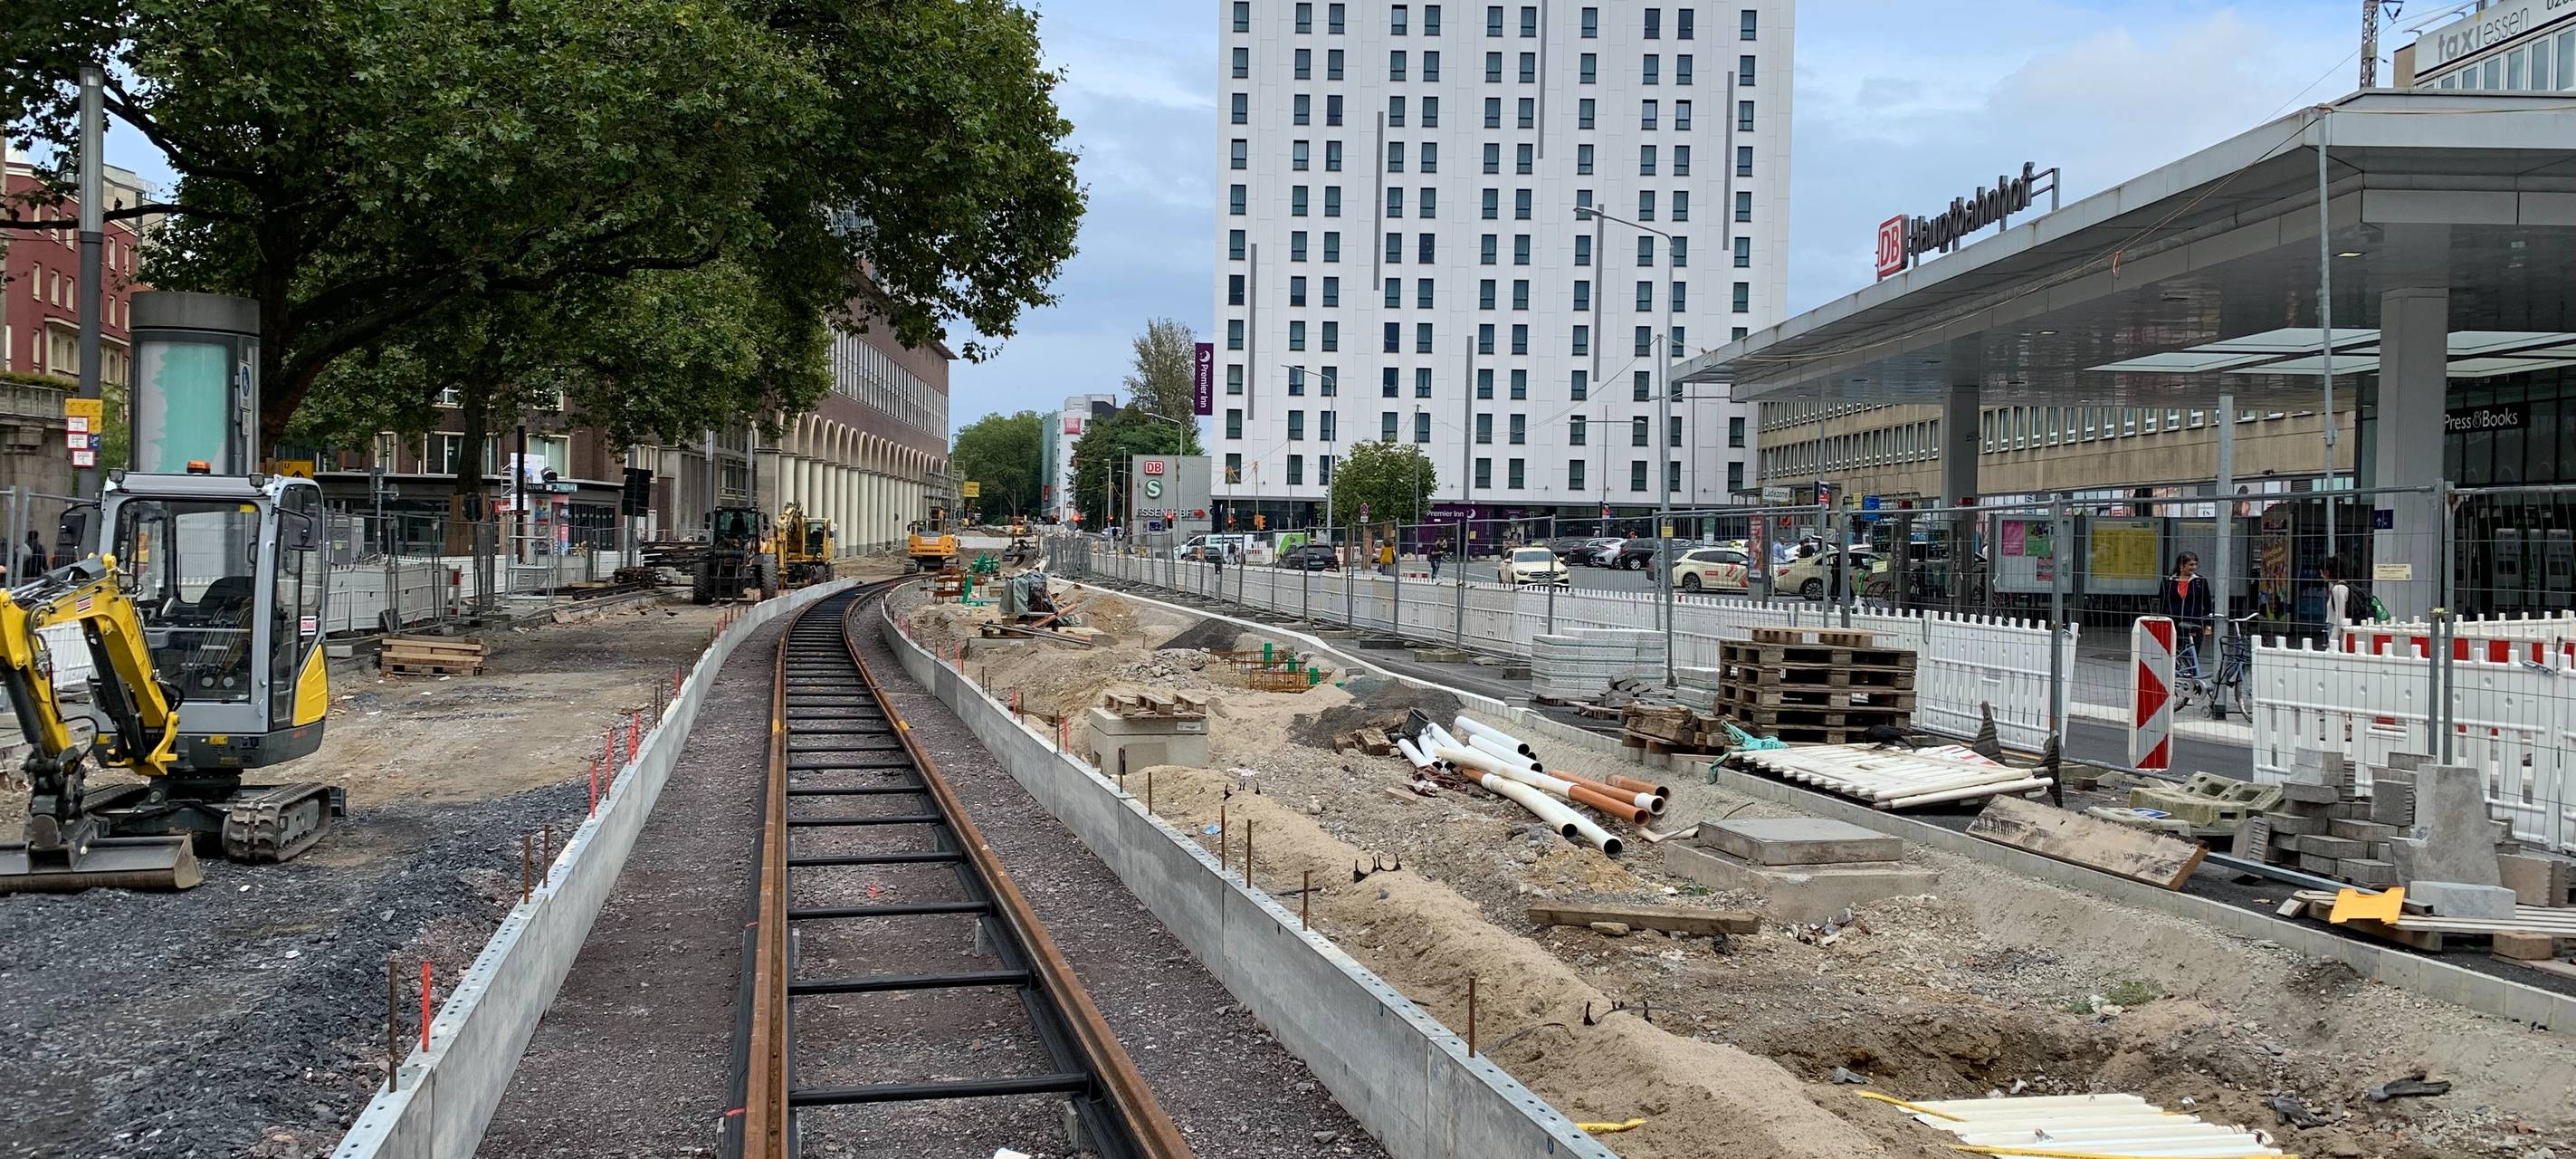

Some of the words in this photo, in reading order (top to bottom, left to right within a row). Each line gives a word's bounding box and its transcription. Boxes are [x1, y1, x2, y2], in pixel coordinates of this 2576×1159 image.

[1880, 225, 1899, 267] DB
[1911, 162, 2034, 255] Hauptbahnhof
[1200, 364, 1208, 395] Premier
[1200, 396, 1208, 408] Inn
[1147, 463, 1162, 473] DB
[1147, 481, 1160, 497] S
[1765, 489, 1788, 498] Ladezone
[1137, 508, 1167, 517] ESSEN
